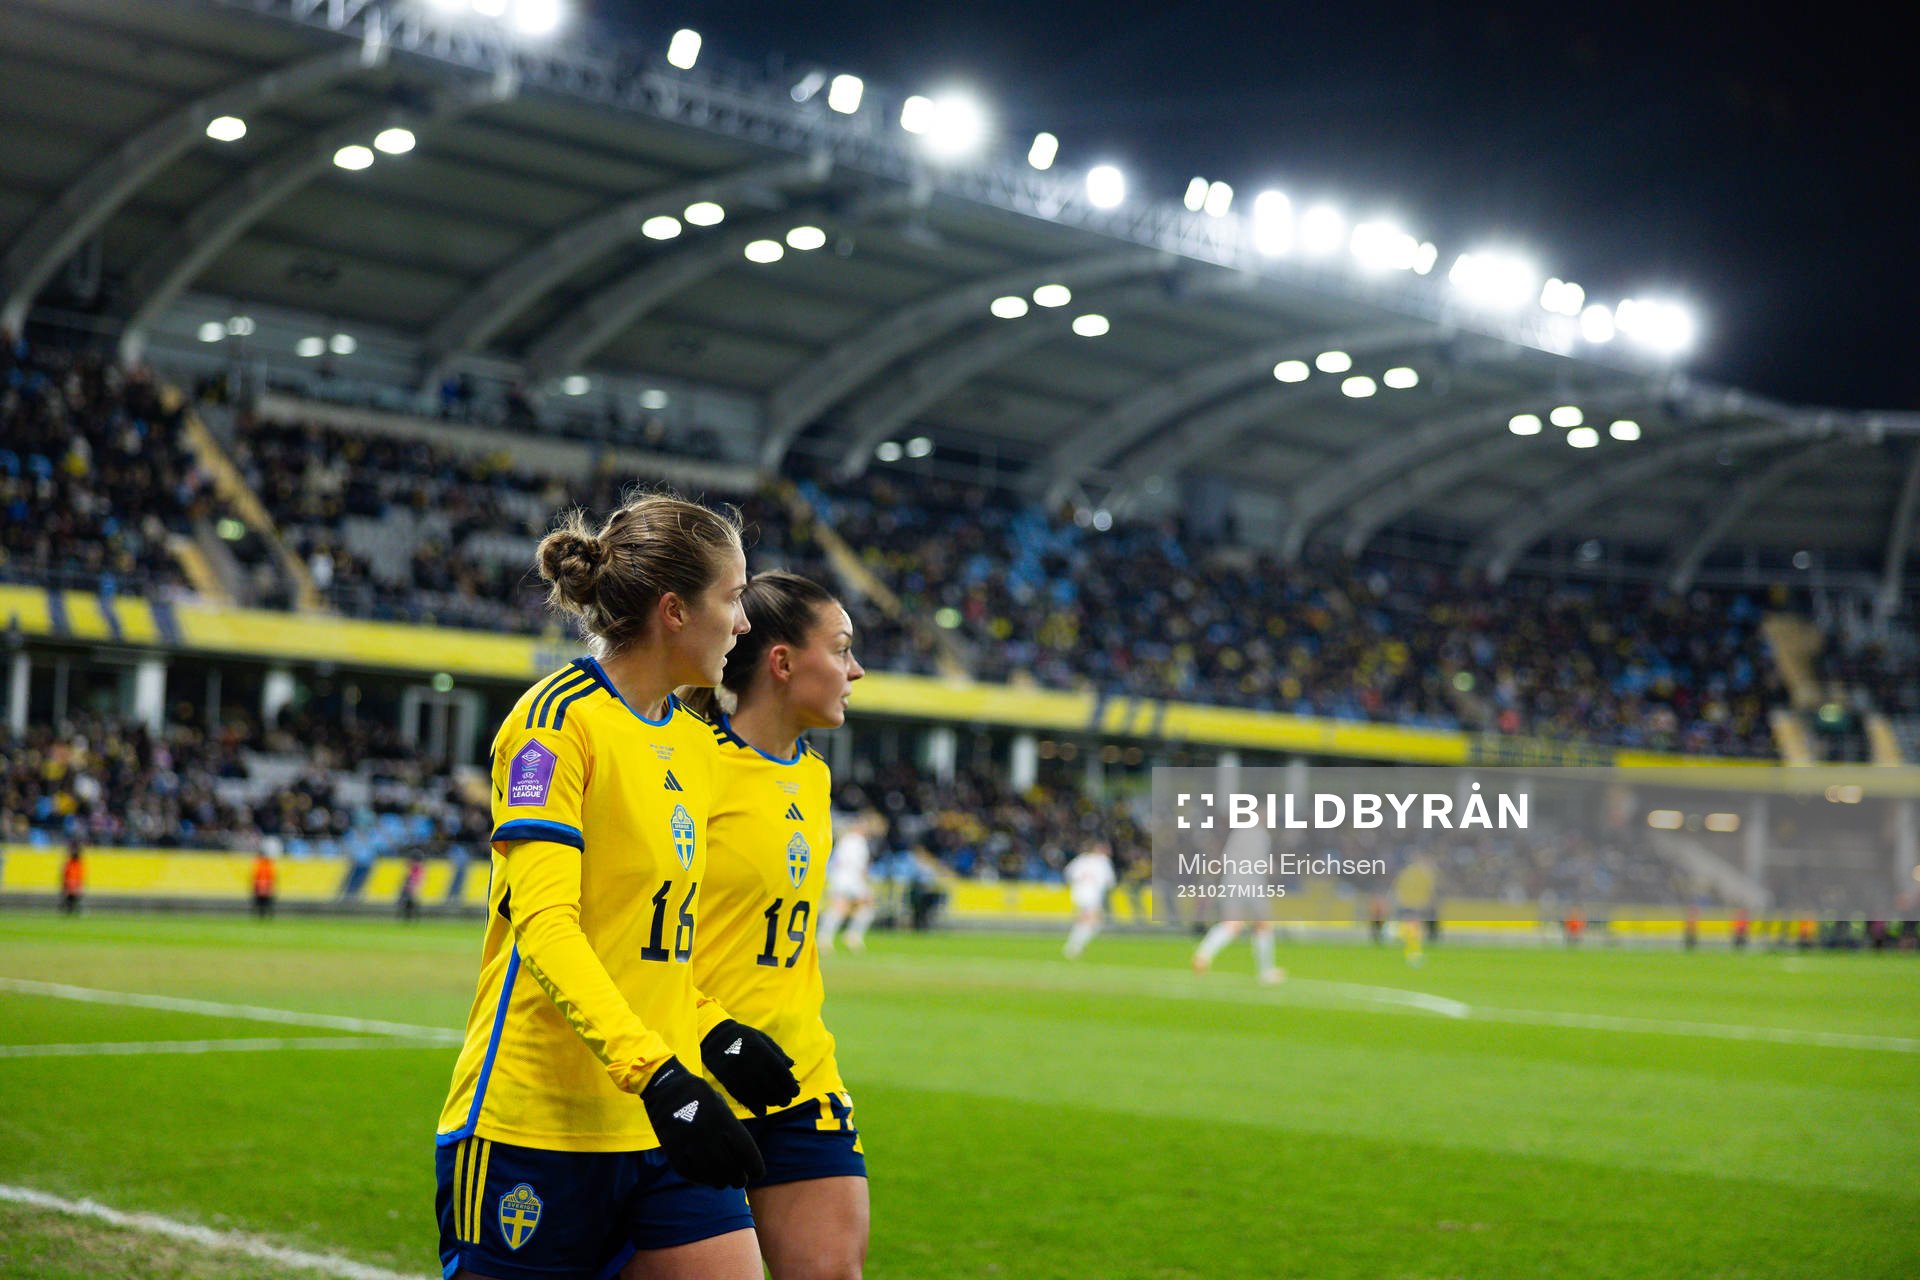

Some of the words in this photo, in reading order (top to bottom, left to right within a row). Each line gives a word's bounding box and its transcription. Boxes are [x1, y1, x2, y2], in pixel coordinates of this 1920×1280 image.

[512, 784, 543, 792] NATIONS
[641, 880, 697, 962] 16
[757, 898, 810, 968] 19
[674, 1100, 699, 1118] adidas
